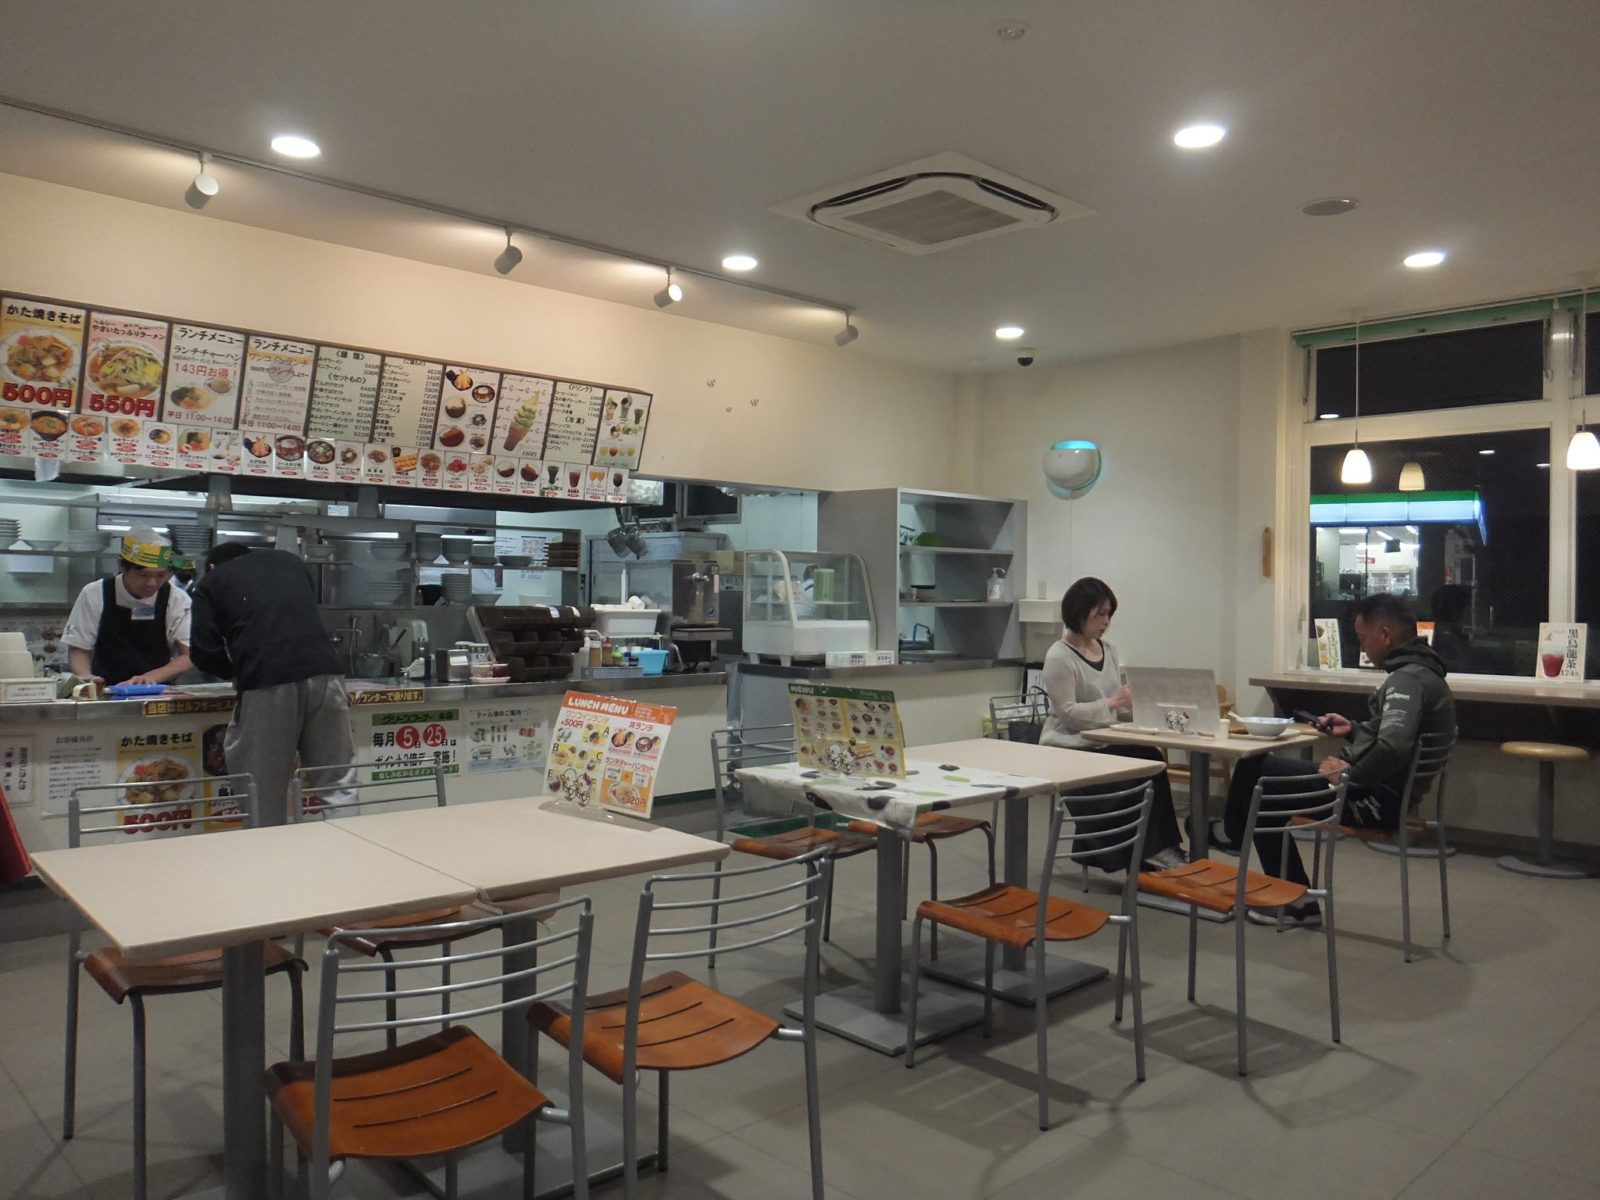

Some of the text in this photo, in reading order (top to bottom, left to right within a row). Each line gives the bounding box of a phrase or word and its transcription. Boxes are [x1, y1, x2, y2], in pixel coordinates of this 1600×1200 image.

[6, 304, 81, 324] かた焼きそば
[179, 327, 244, 344] ランチメニュー
[174, 345, 240, 361] ランチチャーハン
[253, 339, 313, 354] ランチメニュー
[2, 383, 72, 408] 500円
[88, 394, 156, 418] 550円
[568, 697, 600, 710] LUNCH
[600, 702, 629, 715] MENU
[121, 732, 193, 748] かた焼きそば
[123, 808, 193, 834] 500円
